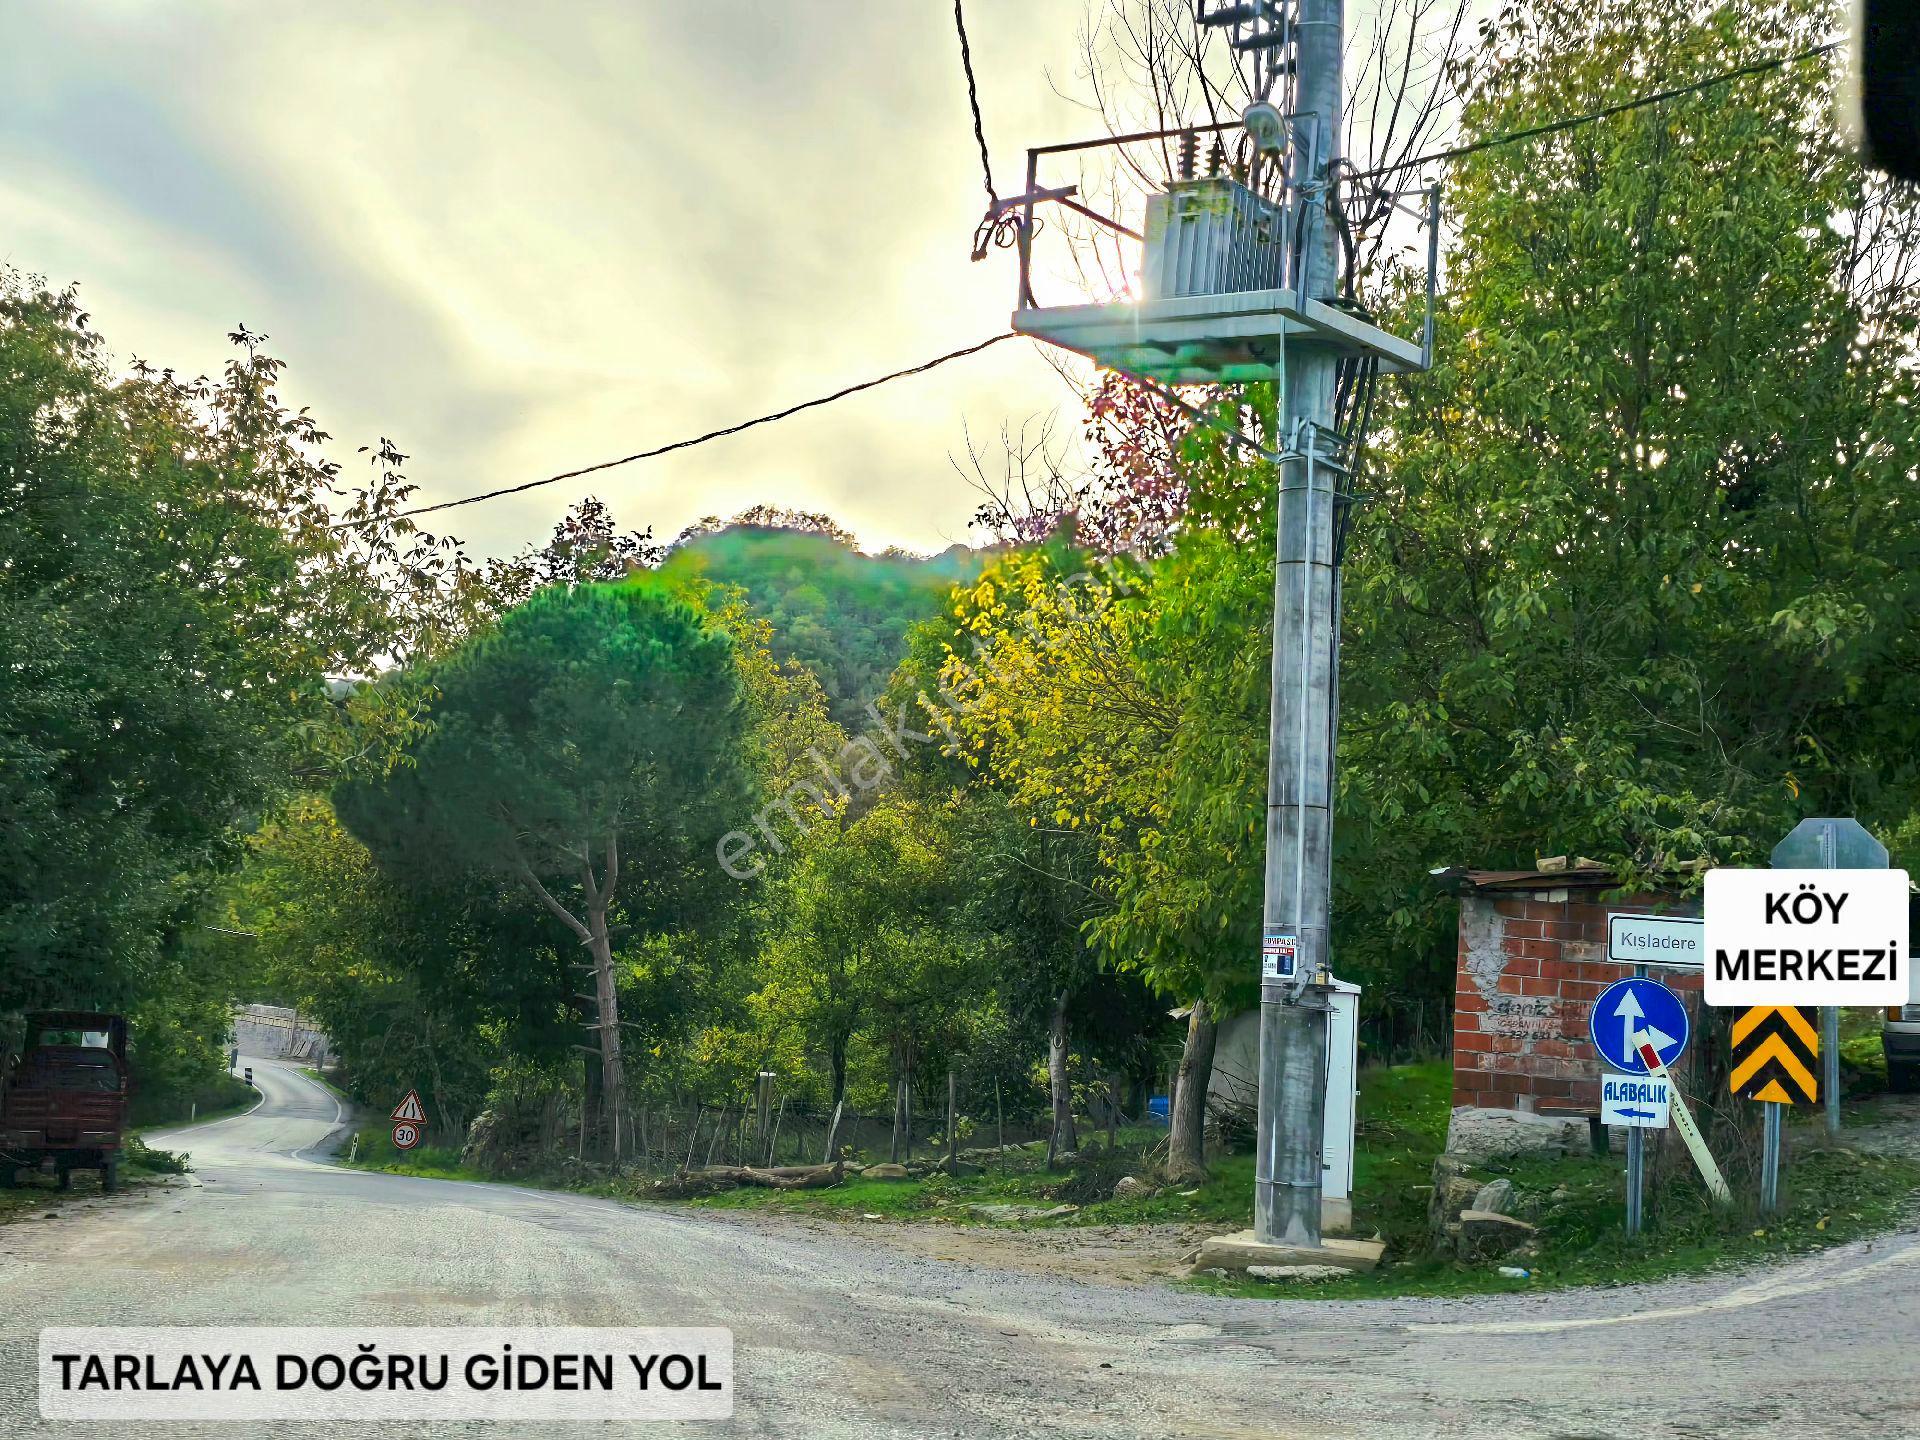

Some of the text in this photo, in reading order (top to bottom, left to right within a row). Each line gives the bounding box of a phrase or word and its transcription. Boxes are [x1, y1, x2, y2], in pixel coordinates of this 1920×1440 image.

[1621, 932, 1696, 950] Kışladere
[1604, 1081, 1667, 1104] ALABALIK
[396, 1130, 413, 1141] 30
